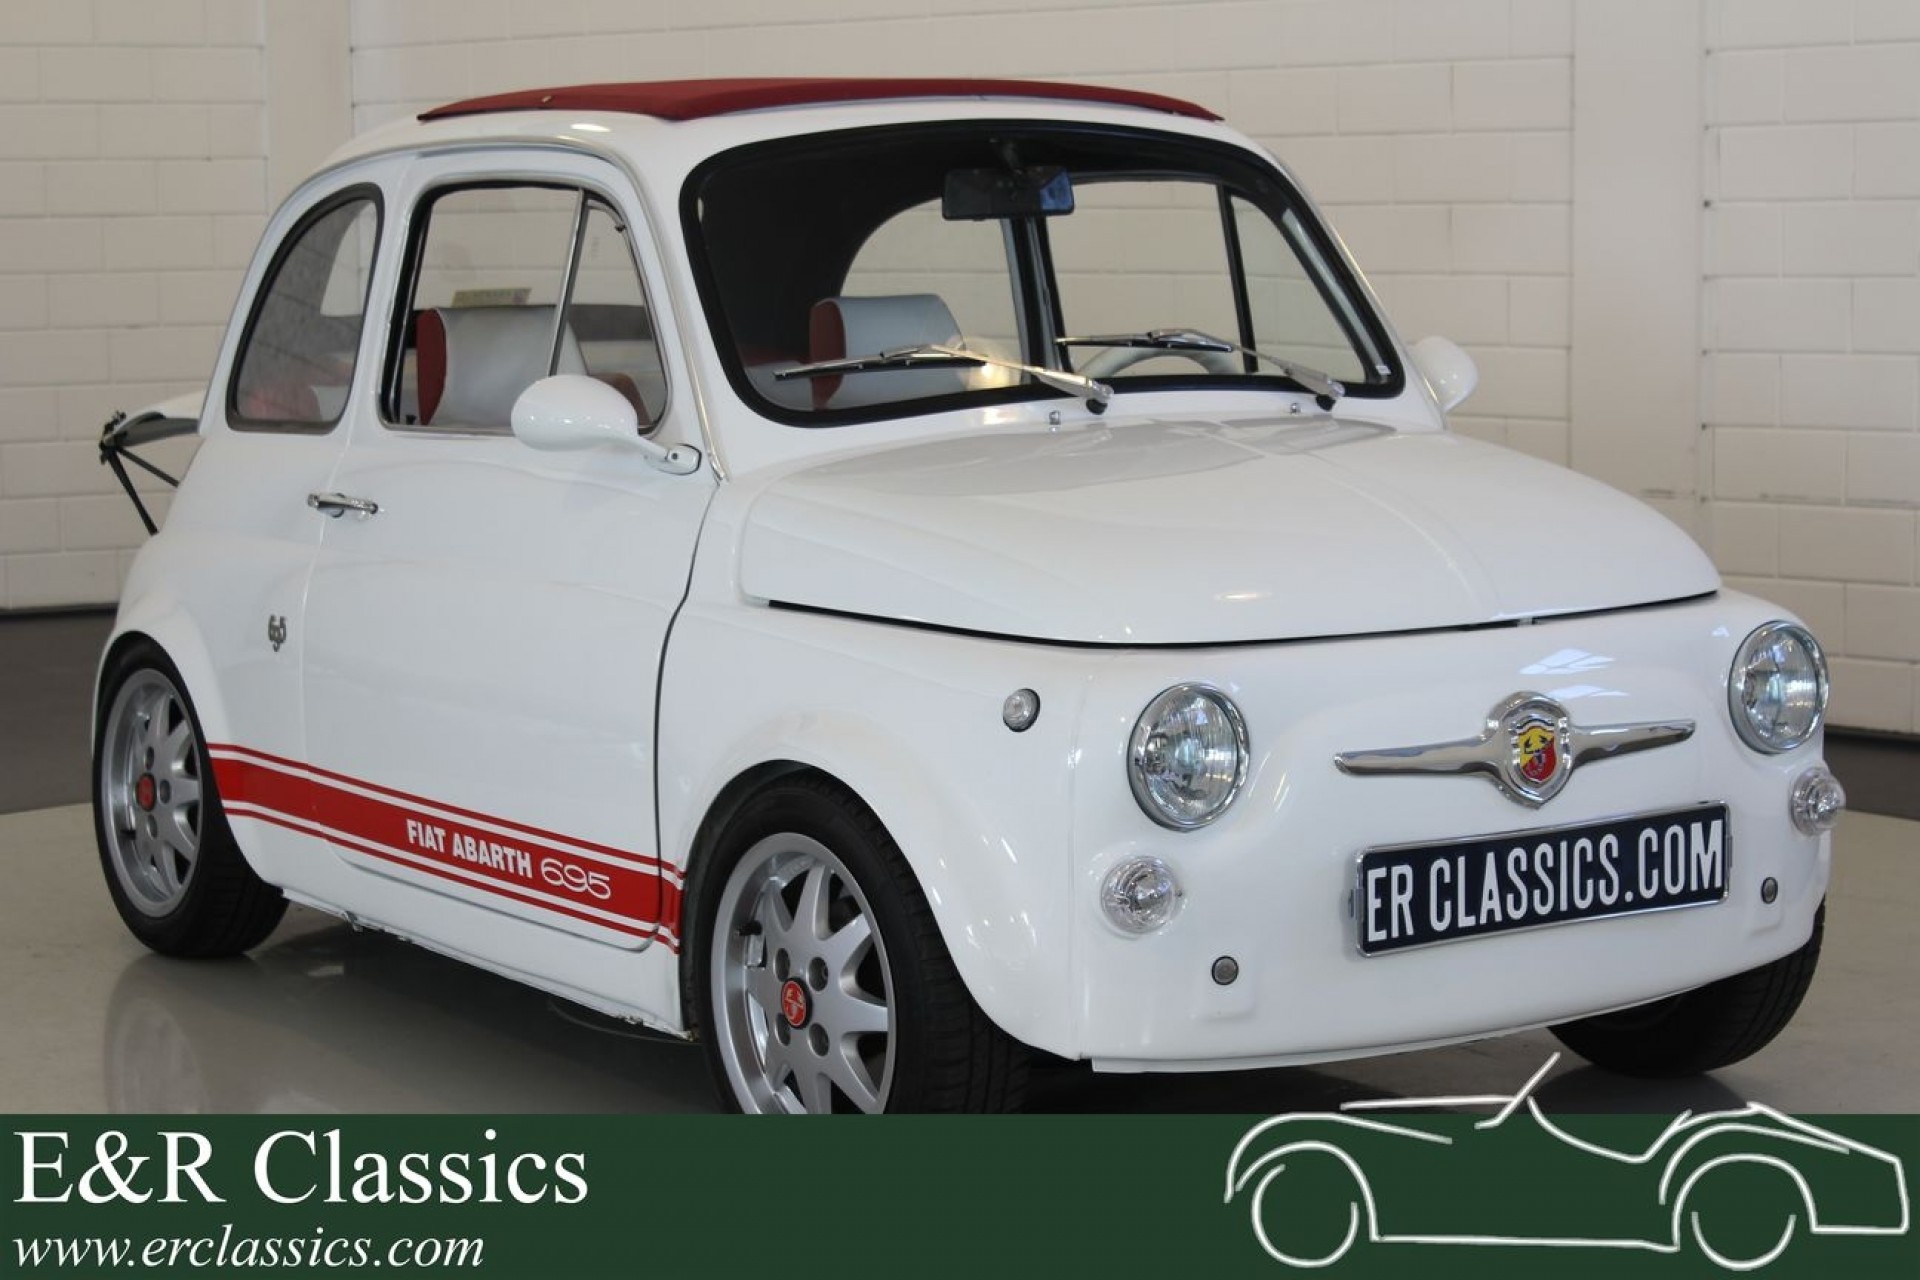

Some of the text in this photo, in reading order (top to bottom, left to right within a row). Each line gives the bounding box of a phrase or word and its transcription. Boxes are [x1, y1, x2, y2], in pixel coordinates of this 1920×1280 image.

[407, 819, 611, 900] FIAT ABARTH 695
[1367, 819, 1723, 943] ER CLASSICS.COM
